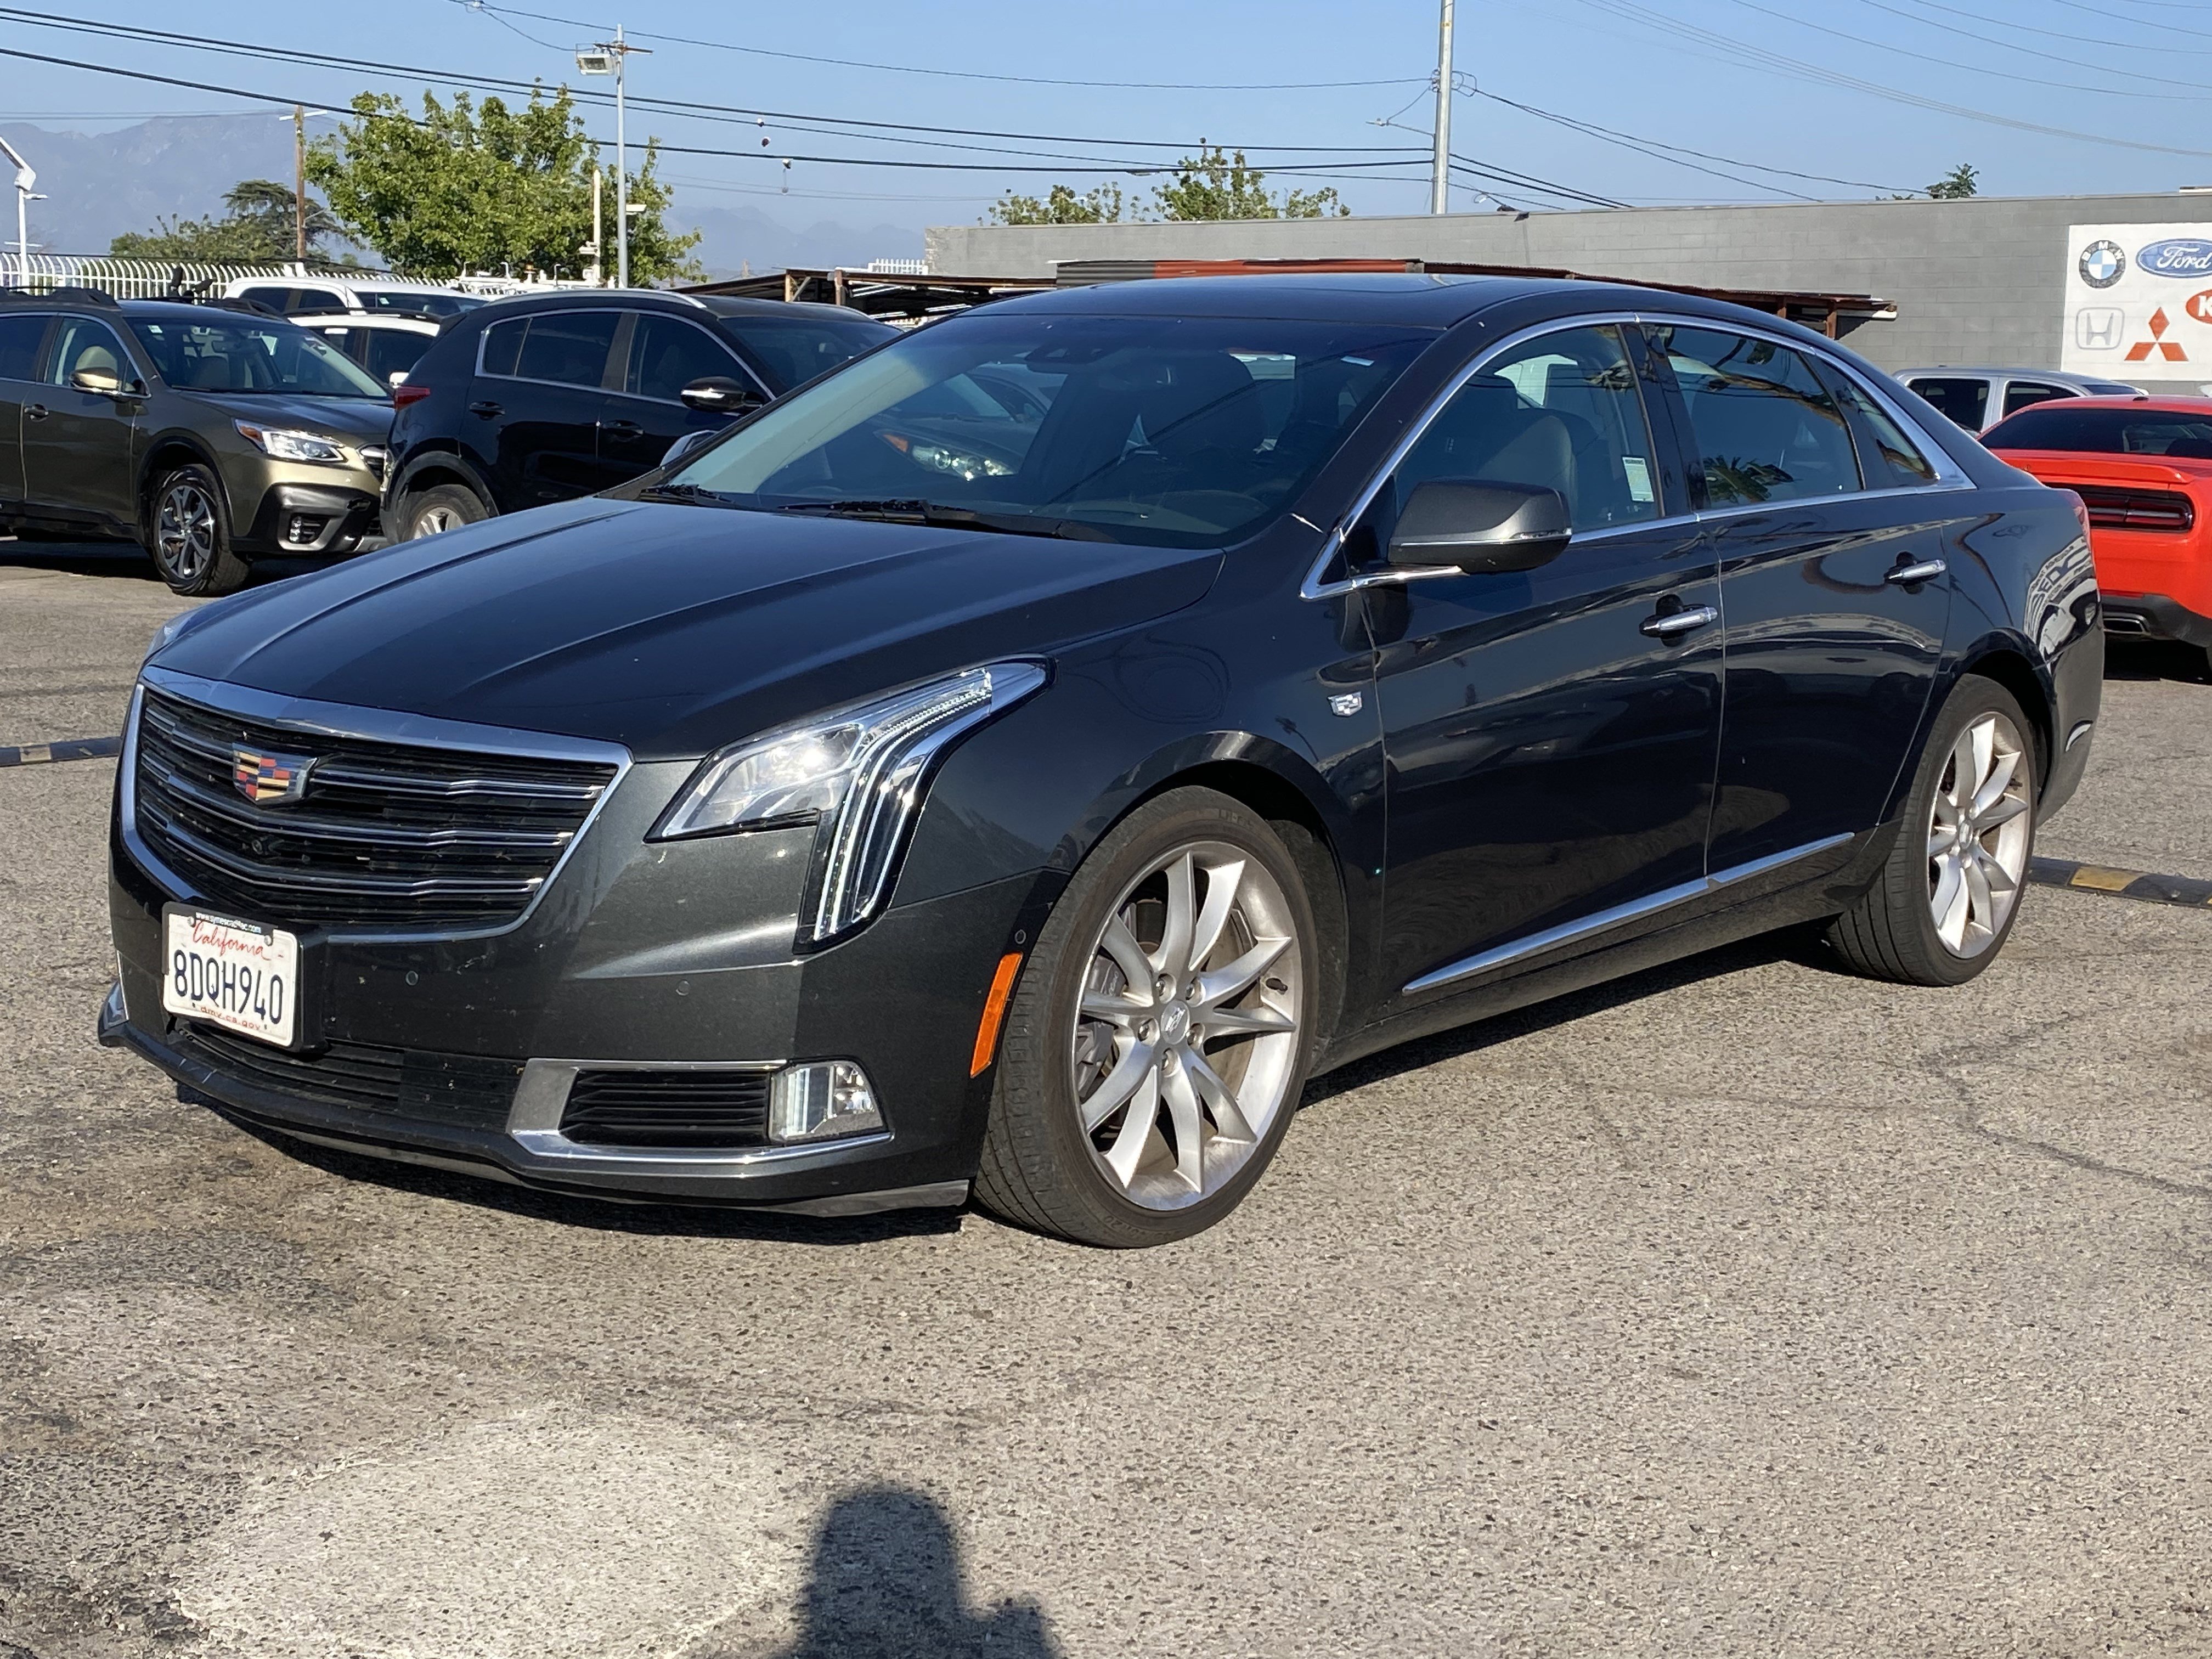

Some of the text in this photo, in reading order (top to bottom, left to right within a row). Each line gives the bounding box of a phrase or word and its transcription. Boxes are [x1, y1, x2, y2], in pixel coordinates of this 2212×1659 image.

[2157, 246, 2212, 269] Ford
[192, 919, 272, 961] California
[174, 949, 284, 1025] 8DQH940
[200, 1006, 261, 1030] dmv.ca.gov
